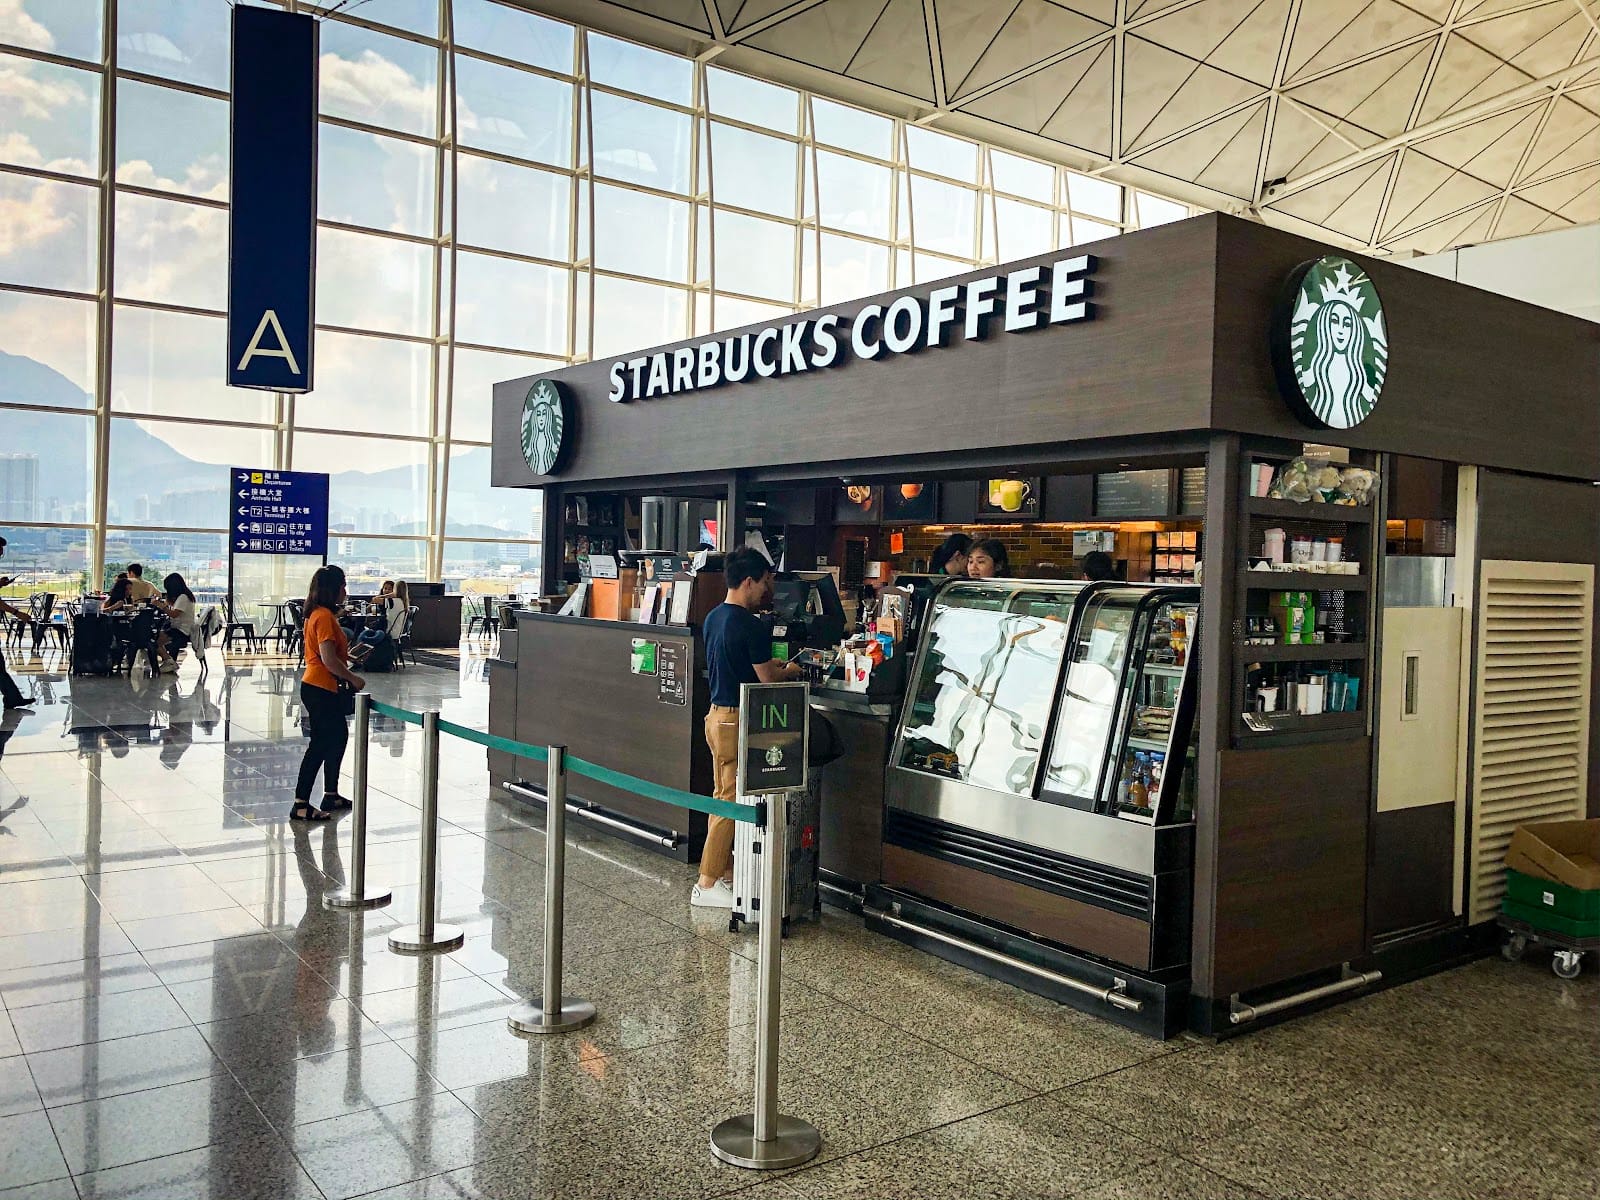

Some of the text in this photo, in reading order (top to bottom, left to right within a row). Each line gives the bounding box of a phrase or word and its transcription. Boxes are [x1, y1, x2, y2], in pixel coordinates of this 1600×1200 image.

[236, 309, 302, 375] A
[608, 254, 1090, 403] STARBUCKS COFFEE
[761, 703, 788, 729] IN
